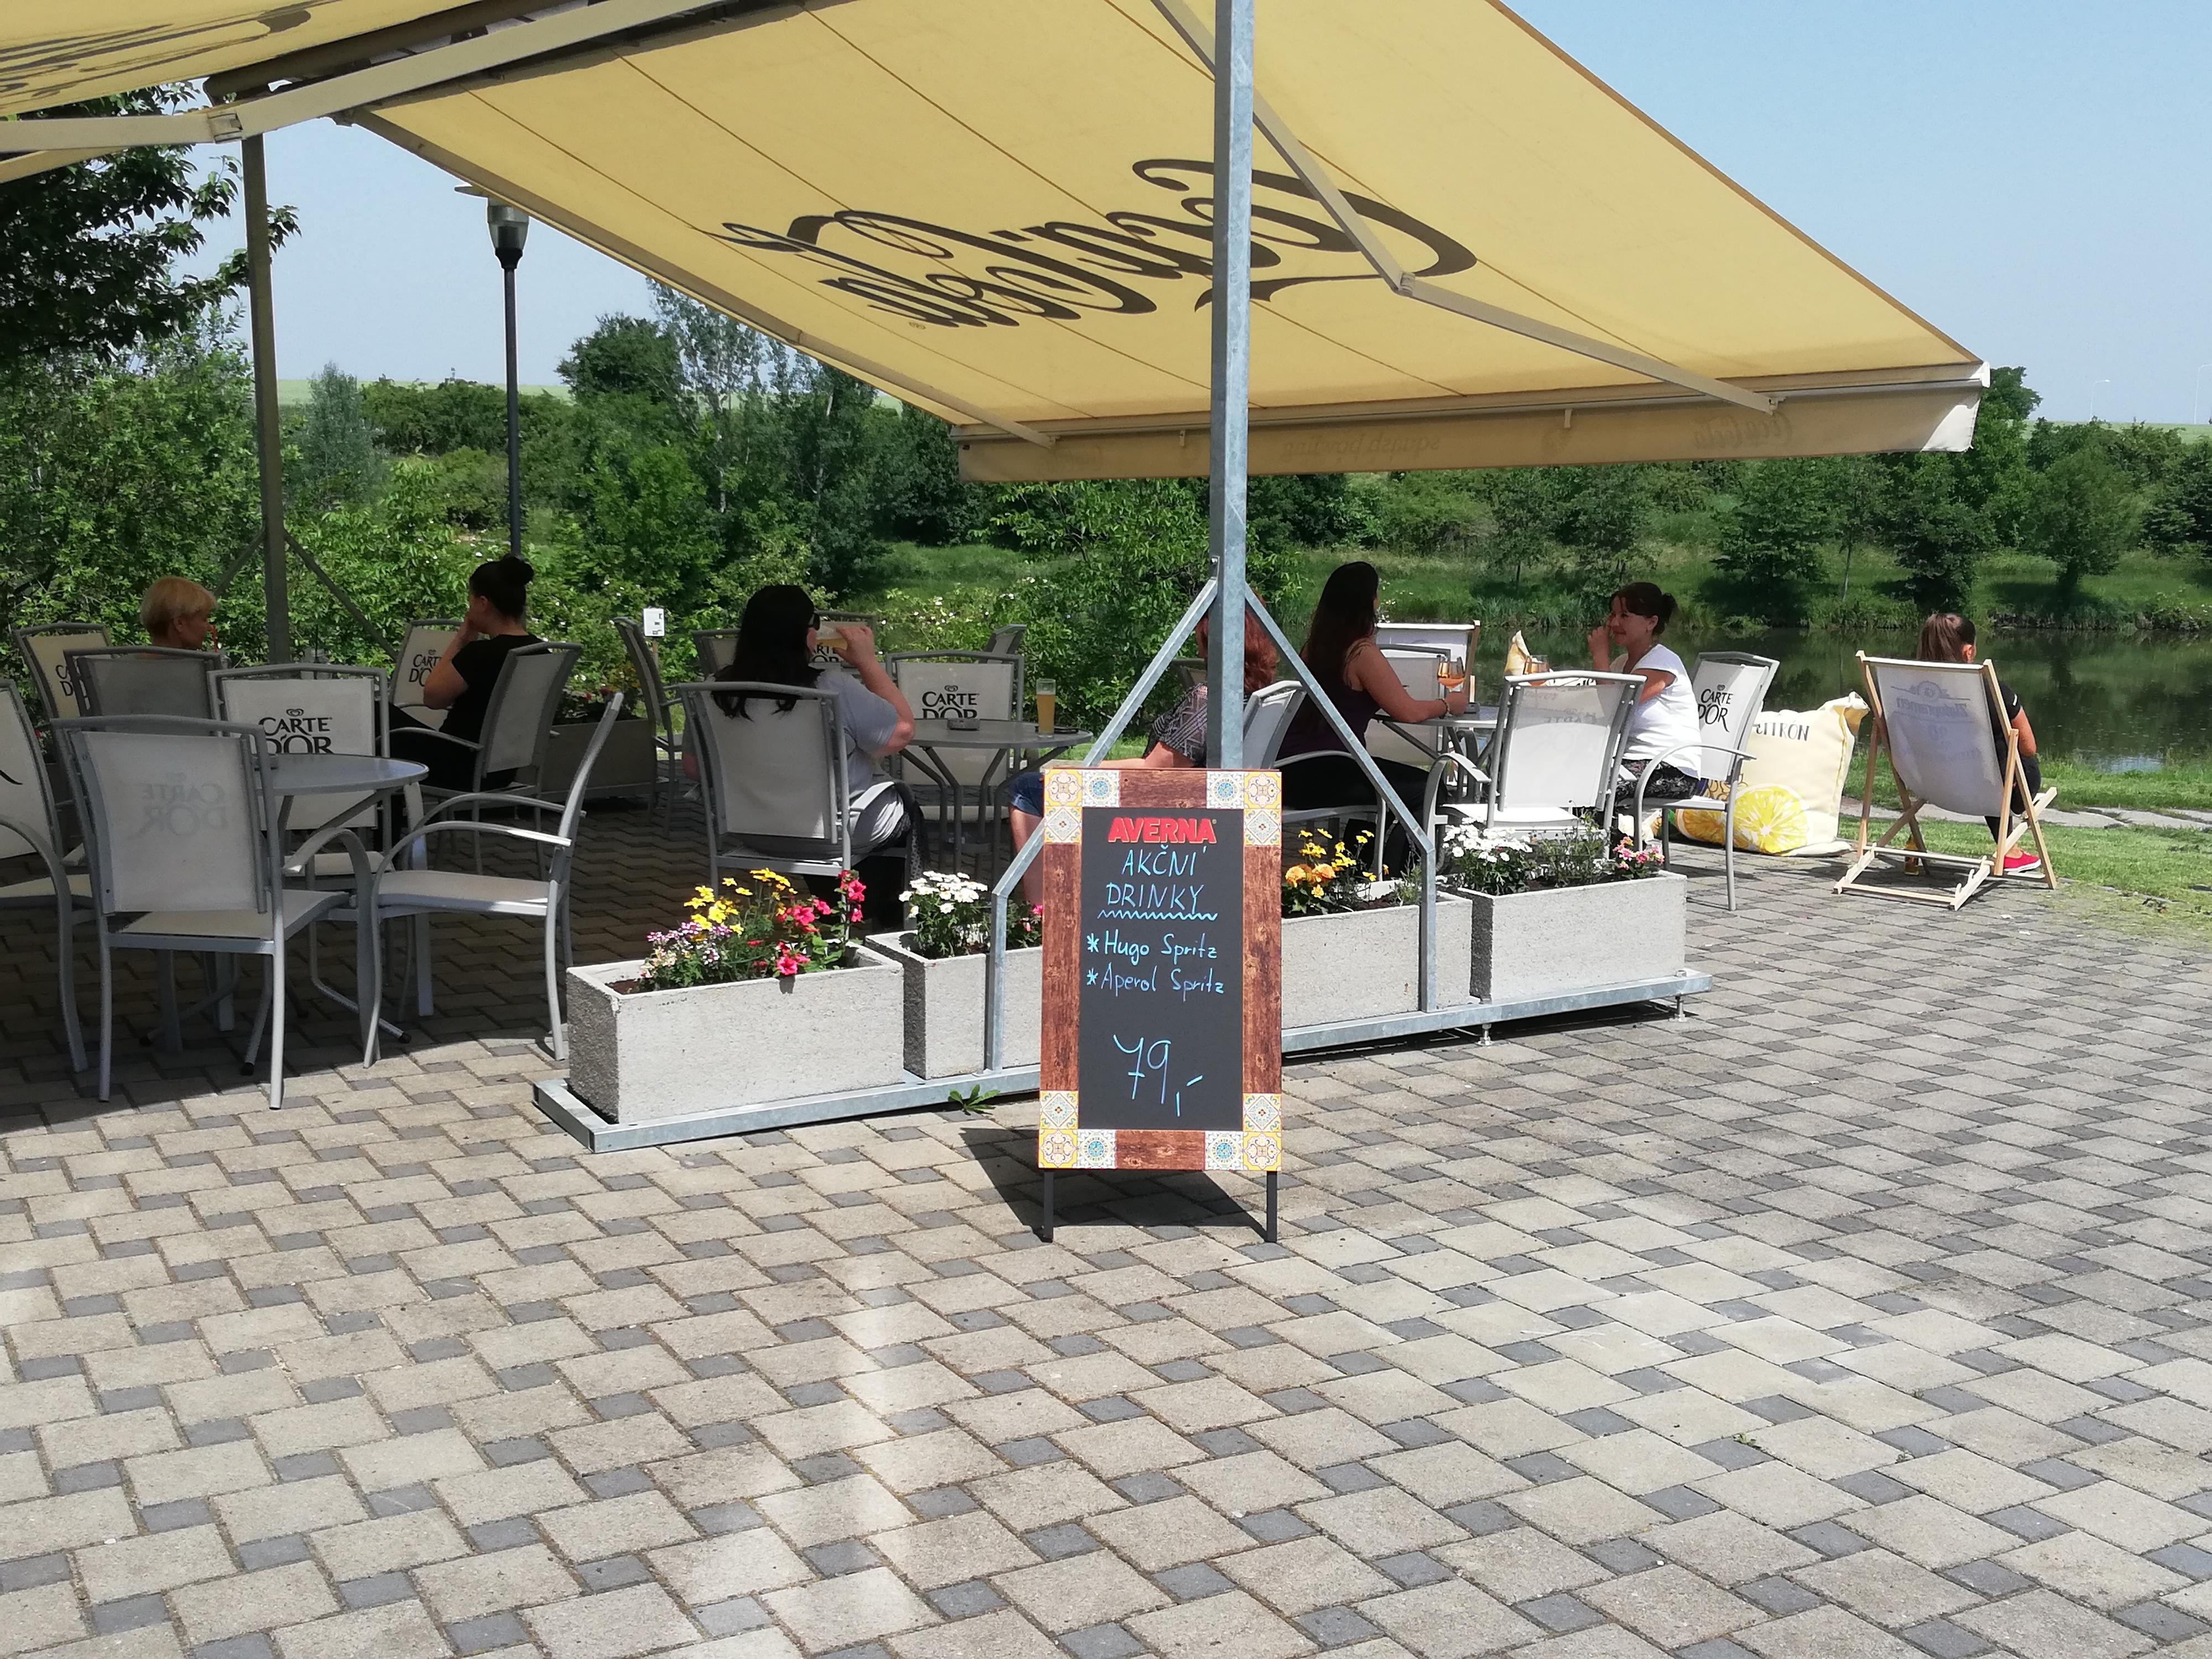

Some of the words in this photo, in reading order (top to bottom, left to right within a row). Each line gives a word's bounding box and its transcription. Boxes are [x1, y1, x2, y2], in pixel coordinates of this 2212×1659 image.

[413, 654, 442, 669] CART
[922, 691, 977, 708] CARTE
[1701, 689, 1732, 706] CARTE
[258, 717, 332, 736] CARTE
[1698, 703, 1730, 733] D'OR
[1108, 817, 1217, 844] AVERNA
[1121, 844, 1207, 877] AKČNÍ
[1107, 883, 1204, 913] DRINKY
[1161, 932, 1217, 965] Spritz
[1171, 968, 1224, 1002] Spritz
